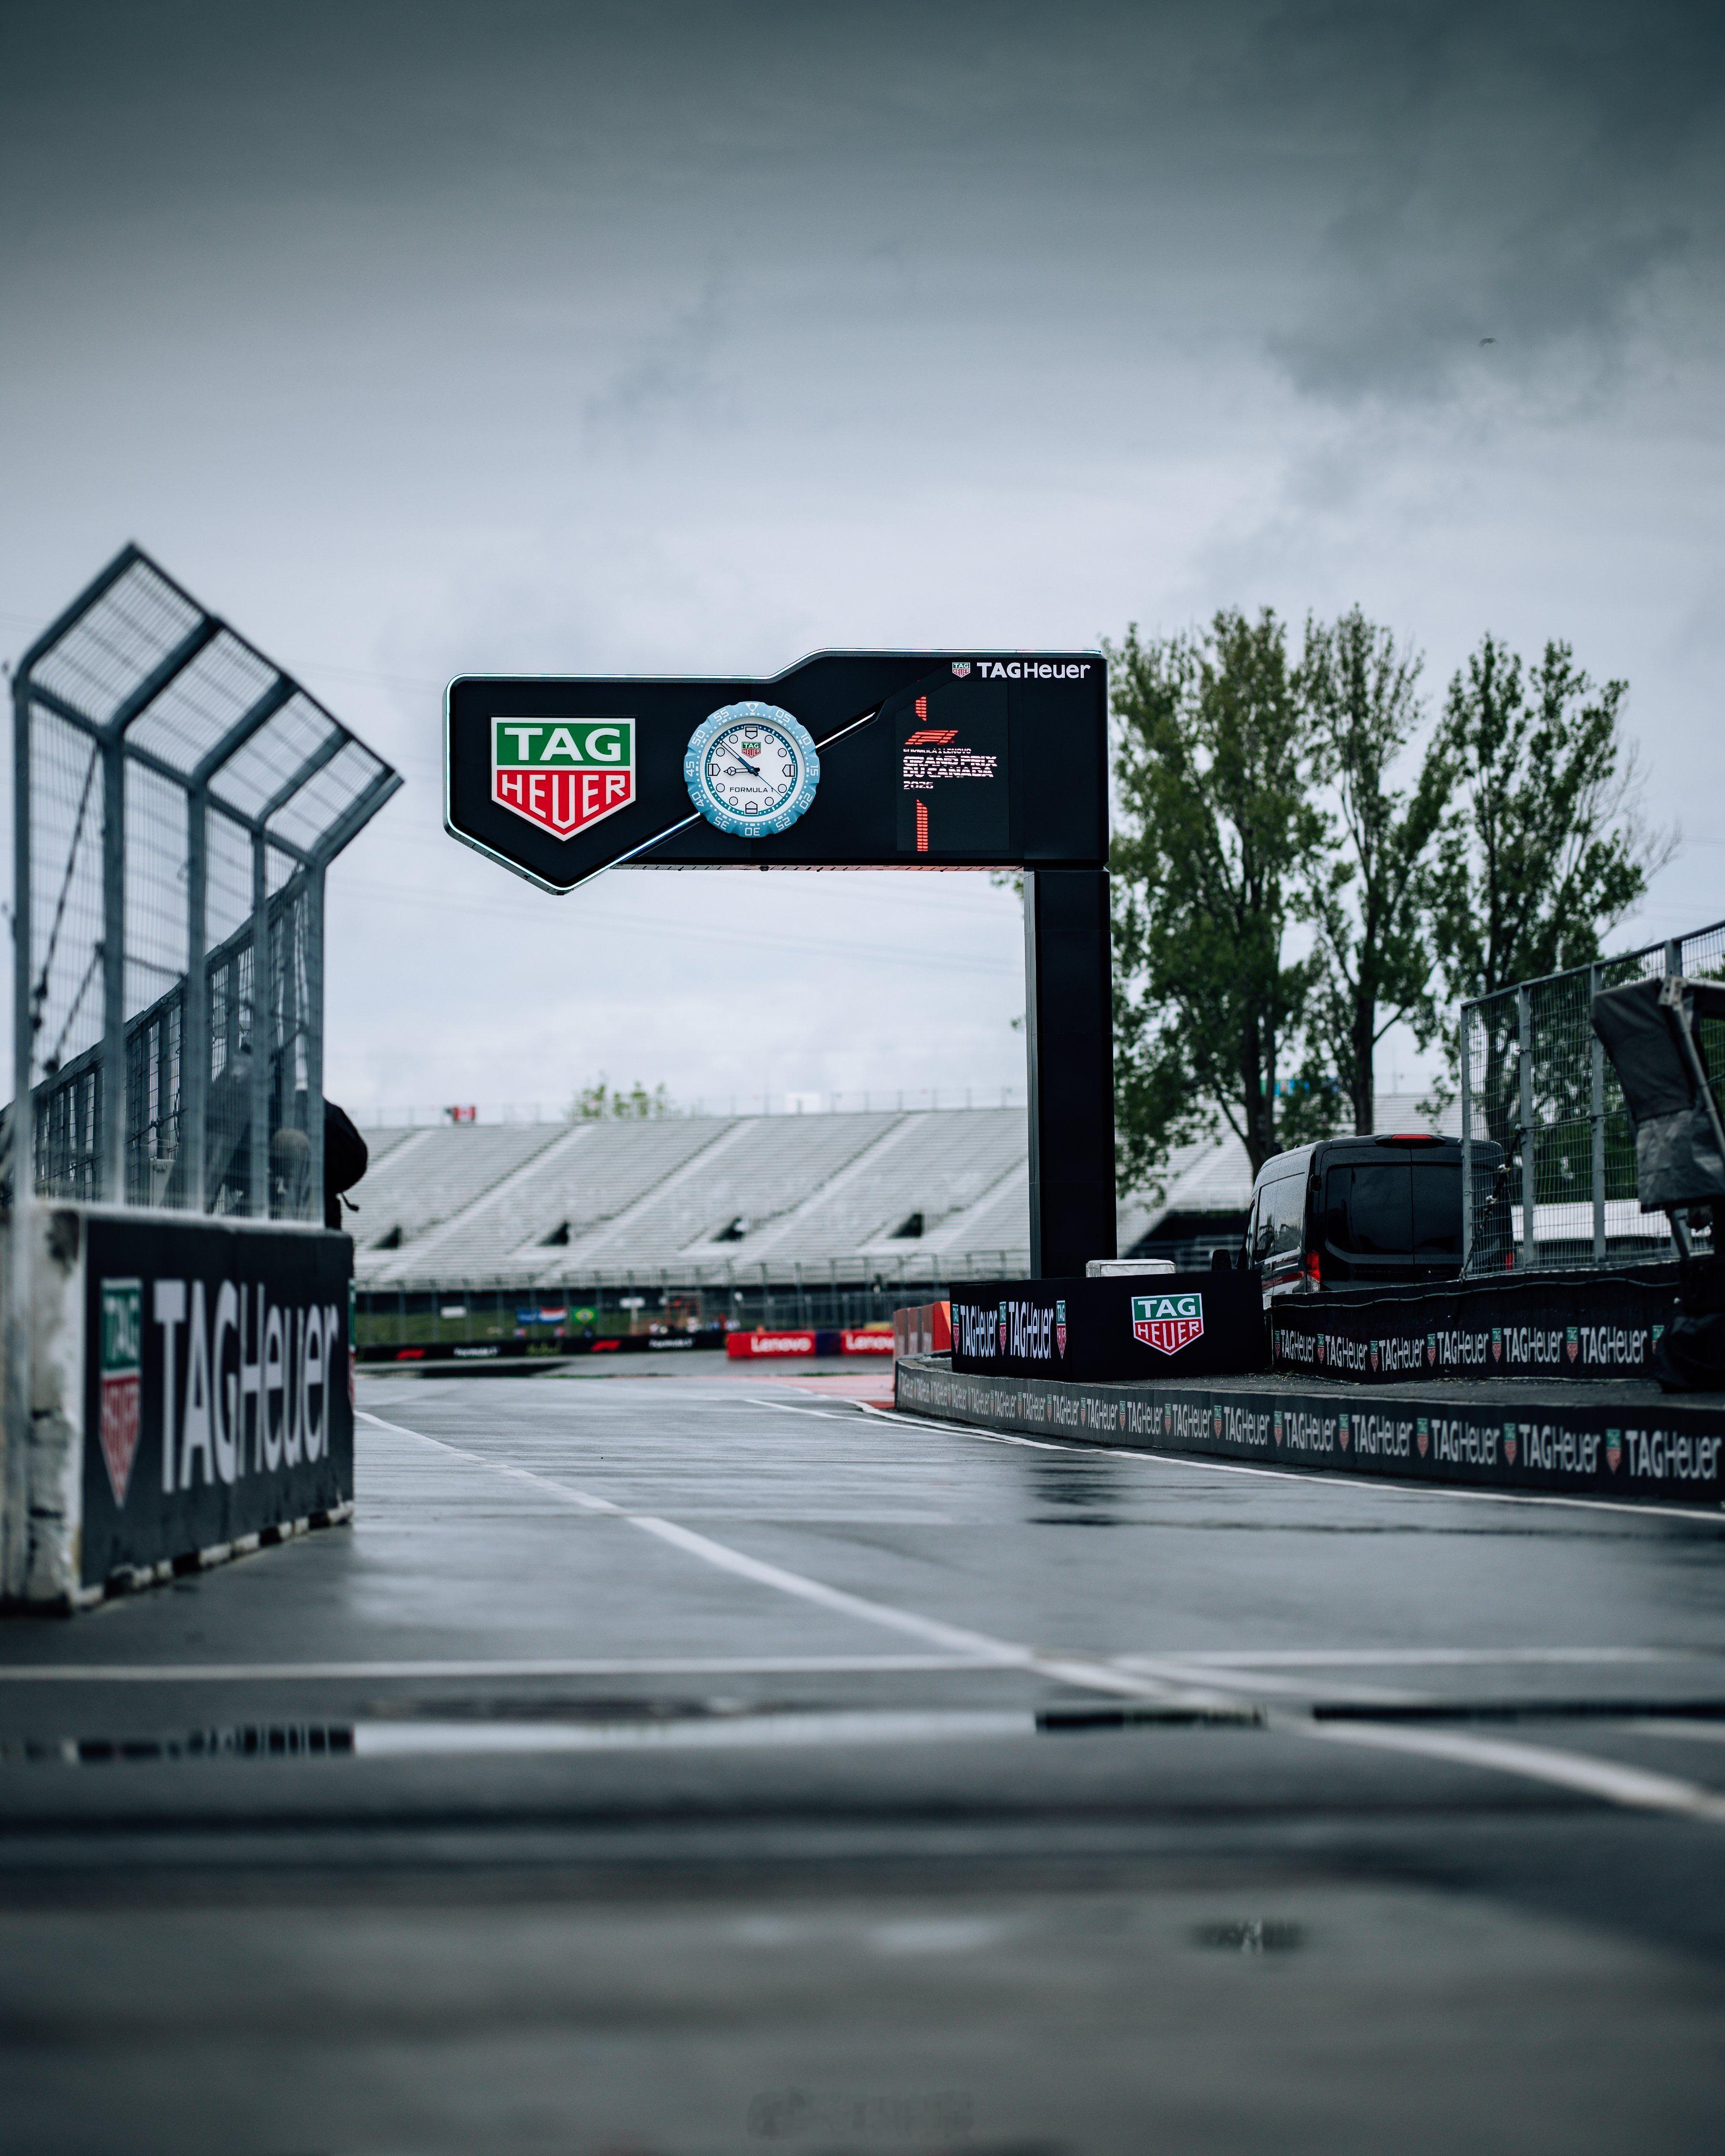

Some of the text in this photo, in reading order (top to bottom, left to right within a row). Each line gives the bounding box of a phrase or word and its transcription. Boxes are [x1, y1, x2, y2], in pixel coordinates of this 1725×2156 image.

[713, 708, 729, 722] 55
[775, 710, 792, 722] 05
[504, 727, 622, 762] TAG
[691, 730, 705, 746] 50
[801, 732, 812, 746] 10
[903, 755, 998, 766] GRAND PRIX
[686, 761, 695, 777] 45
[810, 764, 819, 776] 15
[903, 766, 994, 777] DU CANADA
[903, 781, 934, 790] 2026
[502, 774, 626, 830] HEUER
[691, 791, 704, 807] 40
[800, 793, 813, 810] 20
[713, 816, 730, 830] 35
[775, 816, 792, 831] 25
[744, 827, 760, 836] 30
[1138, 1297, 1196, 1318] TAG
[1137, 1321, 1199, 1350] HEUER
